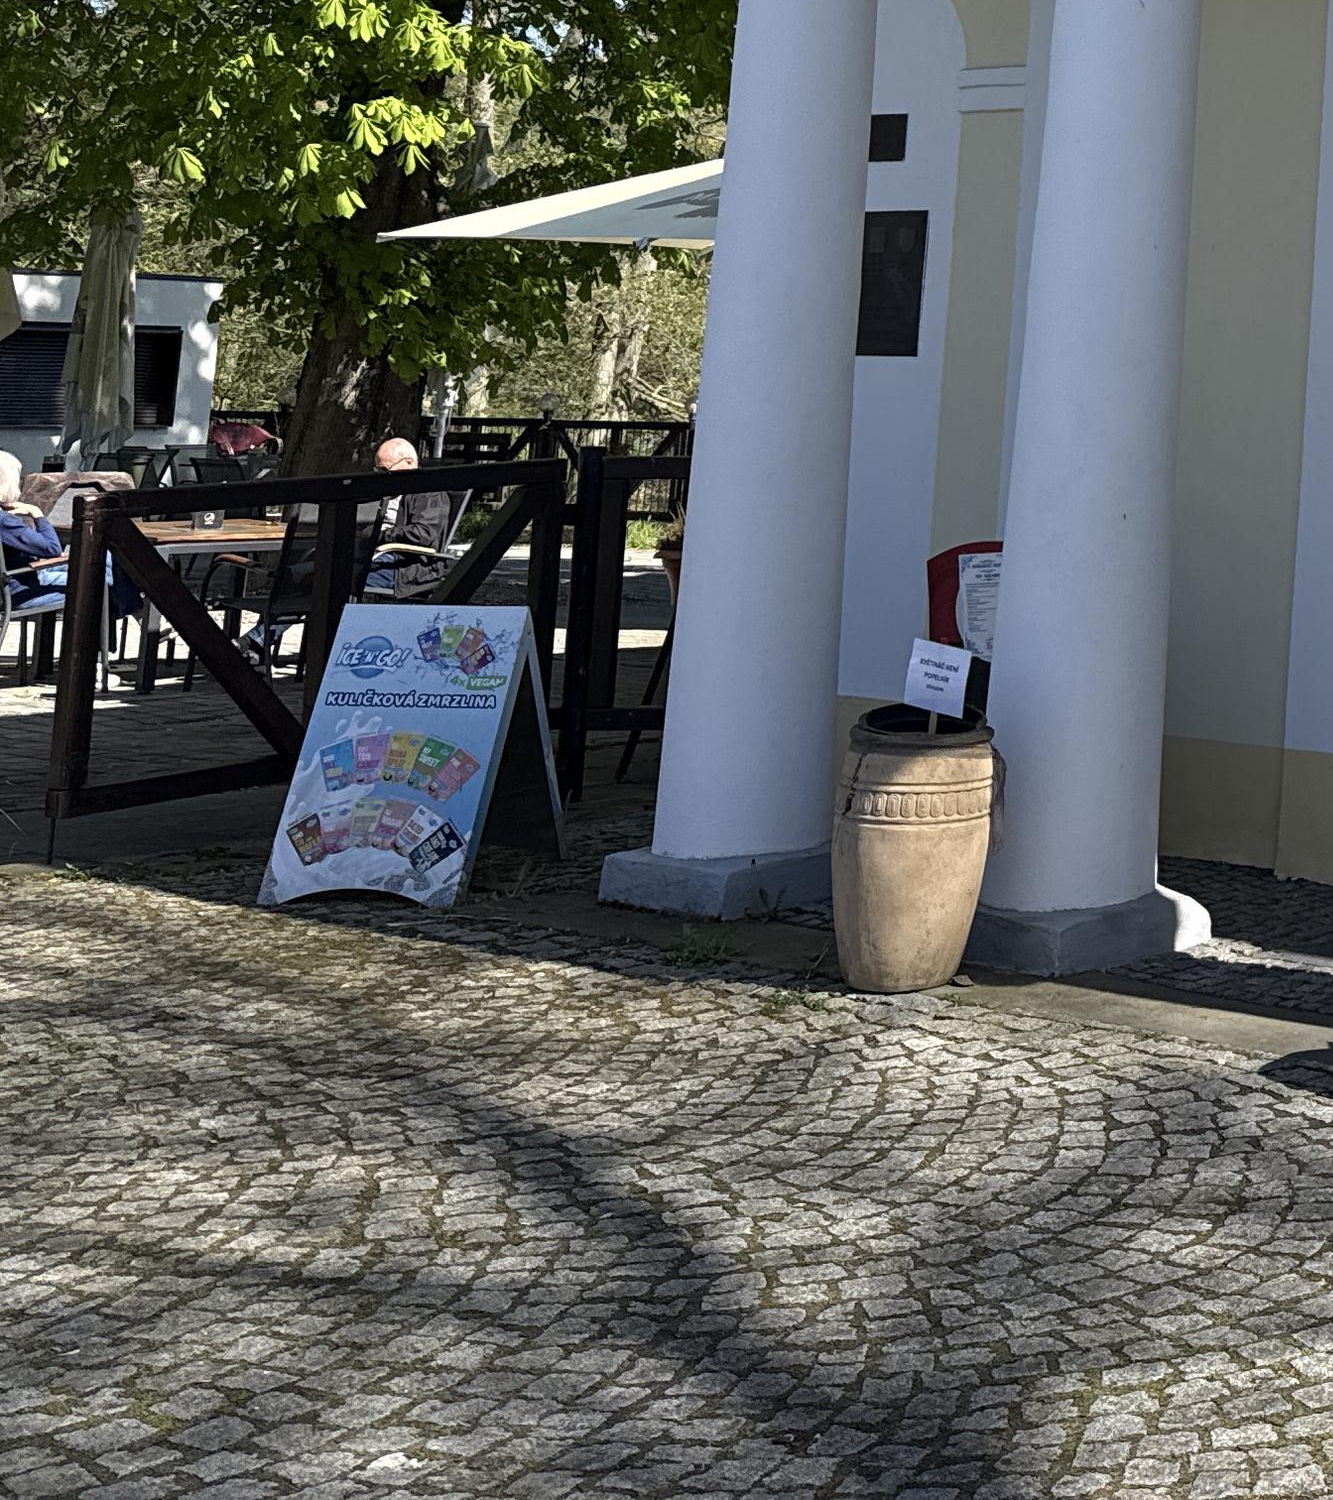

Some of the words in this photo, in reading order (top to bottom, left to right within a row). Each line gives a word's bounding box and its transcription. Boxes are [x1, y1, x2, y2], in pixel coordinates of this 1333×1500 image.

[469, 677, 505, 687] VEGAN
[325, 689, 416, 707] KULIČKOVÁ
[416, 693, 497, 708] ZMRZLINA
